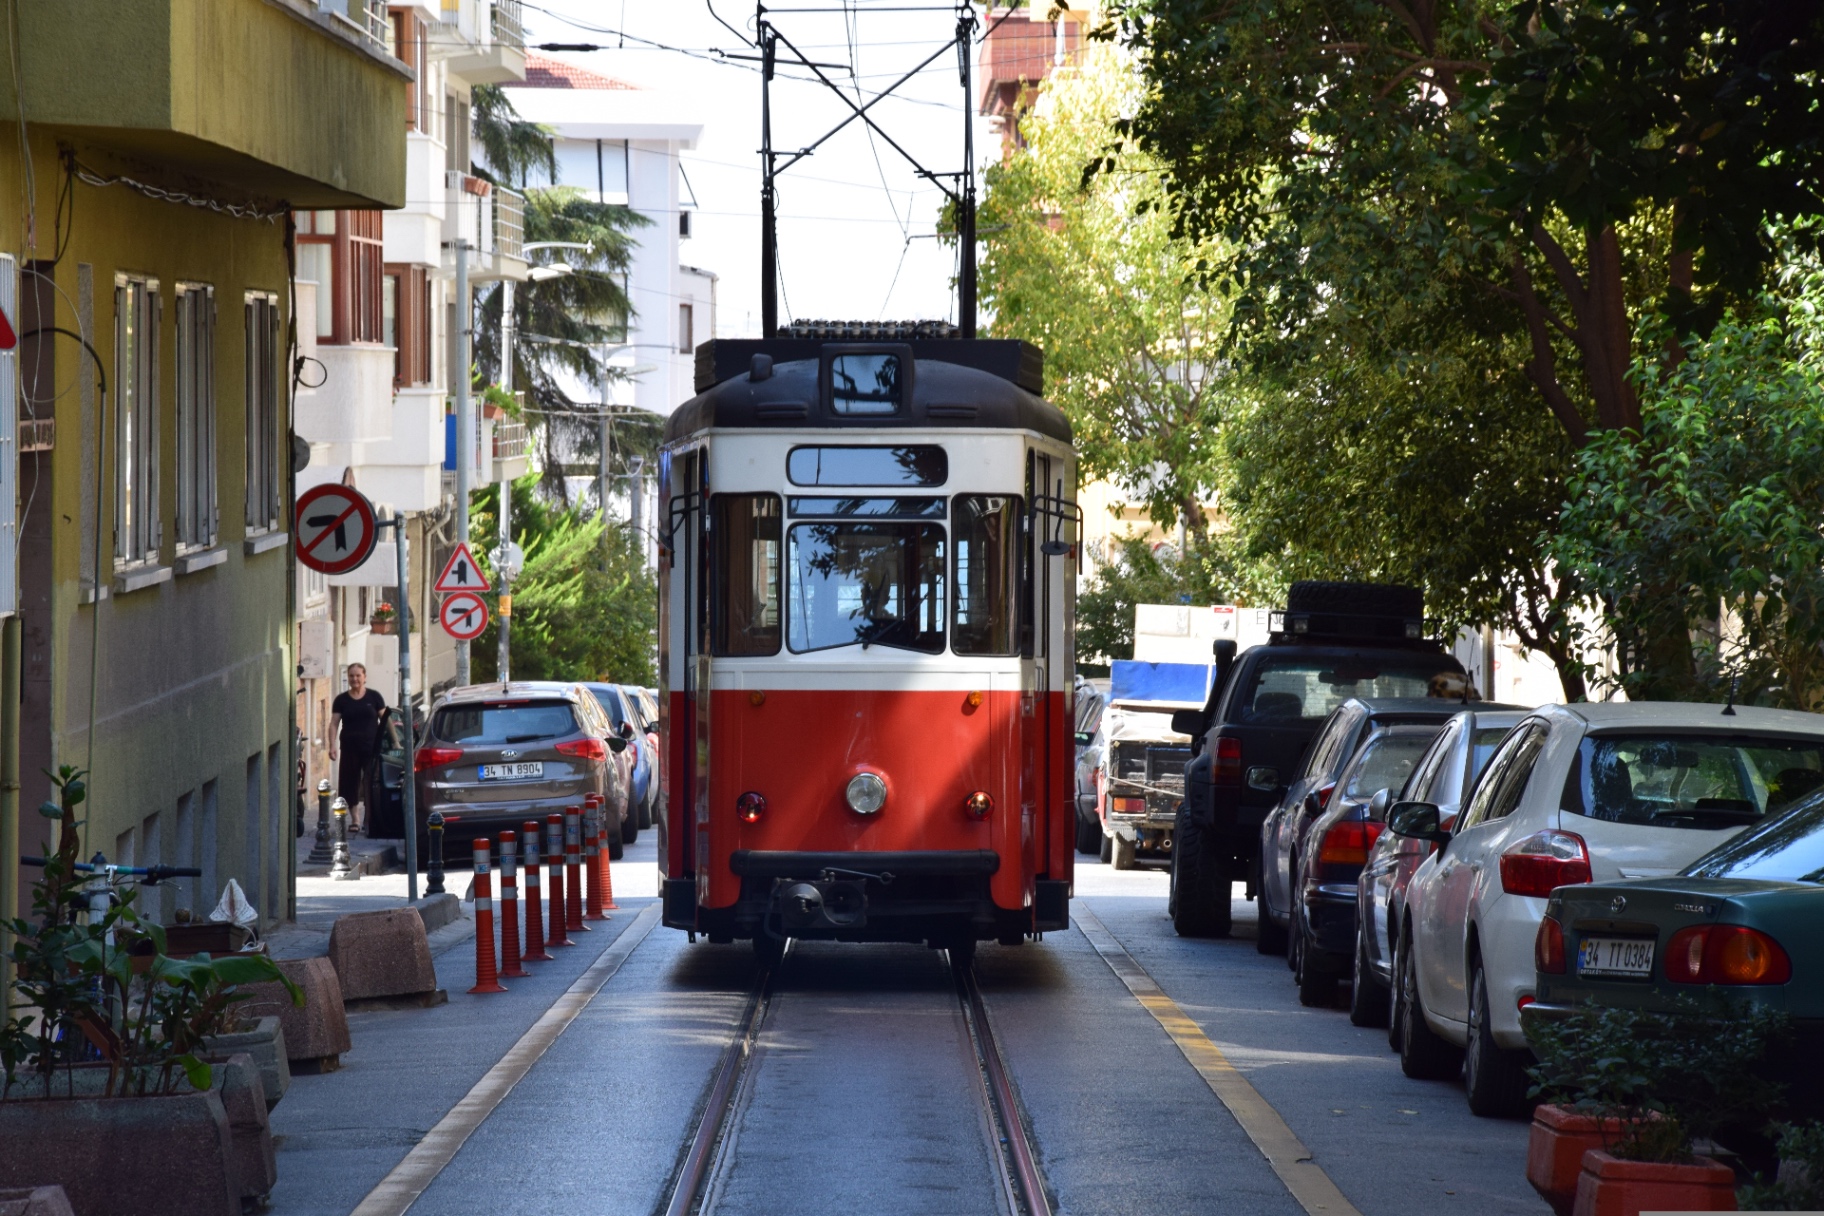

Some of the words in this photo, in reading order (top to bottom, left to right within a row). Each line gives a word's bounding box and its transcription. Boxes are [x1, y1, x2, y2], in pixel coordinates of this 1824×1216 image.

[484, 765, 496, 777] 34
[501, 764, 513, 776] TN
[517, 762, 541, 775] 8904
[1585, 941, 1600, 967] 34
